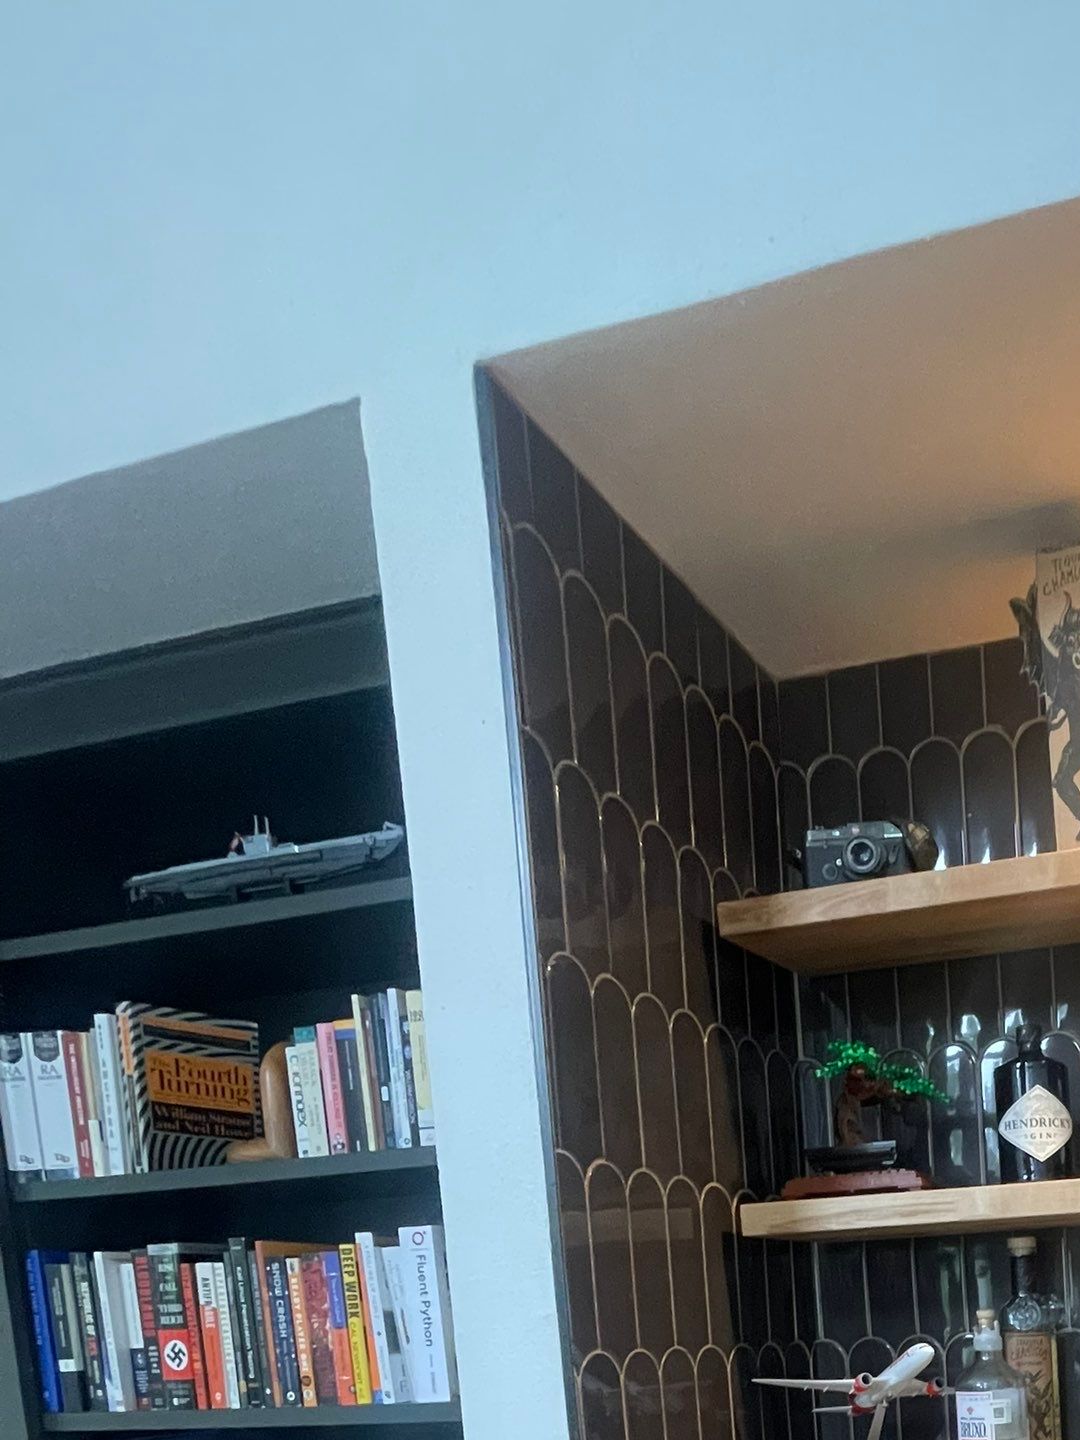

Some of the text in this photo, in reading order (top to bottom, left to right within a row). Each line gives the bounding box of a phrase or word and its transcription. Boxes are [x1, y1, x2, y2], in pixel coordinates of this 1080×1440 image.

[151, 1068, 249, 1107] Turning
[174, 1058, 248, 1086] Fourth
[1030, 1132, 1052, 1140] GIN
[270, 1262, 283, 1297] SNOW
[341, 1247, 355, 1275] DEEP
[415, 1254, 430, 1296] Fluent
[291, 1277, 301, 1310] READY
[345, 1281, 360, 1319] WORK
[275, 1300, 288, 1338] CRASH
[295, 1312, 306, 1351] PLAYER
[420, 1300, 434, 1347] Python
